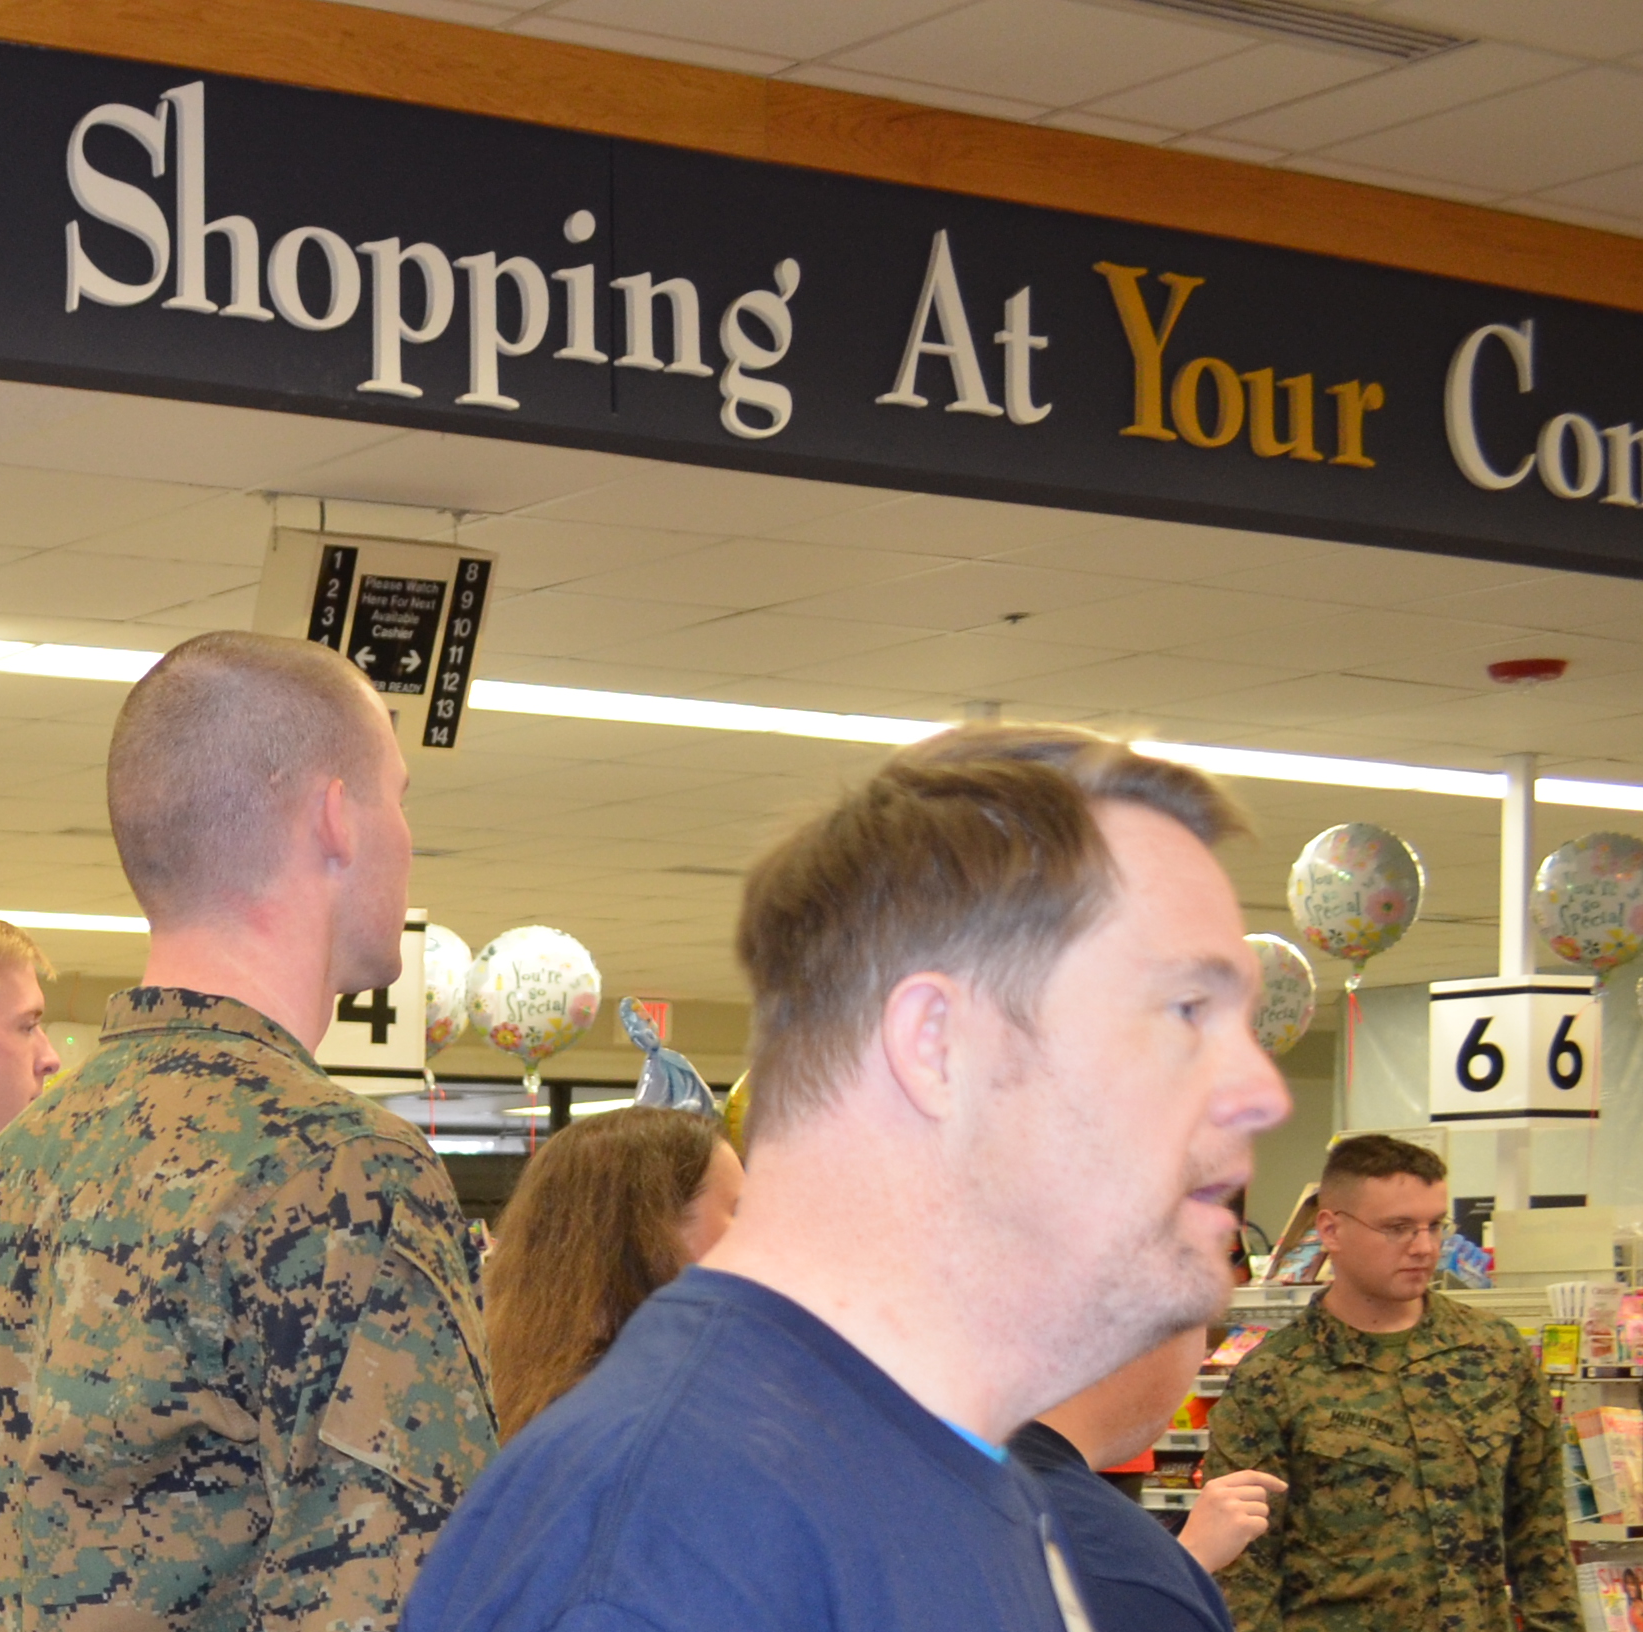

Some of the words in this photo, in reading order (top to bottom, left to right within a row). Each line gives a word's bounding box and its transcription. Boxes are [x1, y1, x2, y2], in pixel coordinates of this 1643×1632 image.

[65, 80, 801, 439] Shopping
[874, 228, 1054, 426] At
[1093, 260, 1385, 469] Your
[334, 550, 343, 569] 1
[465, 563, 479, 582] 8
[326, 578, 340, 598] 2
[365, 577, 403, 591] Please
[406, 580, 440, 594] Watch
[362, 594, 387, 606] Here
[390, 595, 409, 608] For
[411, 597, 436, 610] Next
[461, 590, 474, 609] 9
[321, 606, 335, 625] 3
[371, 609, 420, 625] Available
[371, 625, 415, 640] Cashier
[453, 618, 472, 637] 10
[449, 646, 465, 665] 11
[388, 681, 423, 693] READY
[442, 672, 460, 691] 12
[436, 699, 455, 719] 13
[430, 726, 449, 745] 14
[1559, 903, 1625, 936] Special
[512, 961, 563, 993] You're
[337, 988, 396, 1044] 4
[506, 991, 567, 1023] Special
[1456, 1015, 1505, 1092] 6
[1548, 1014, 1583, 1090] 6
